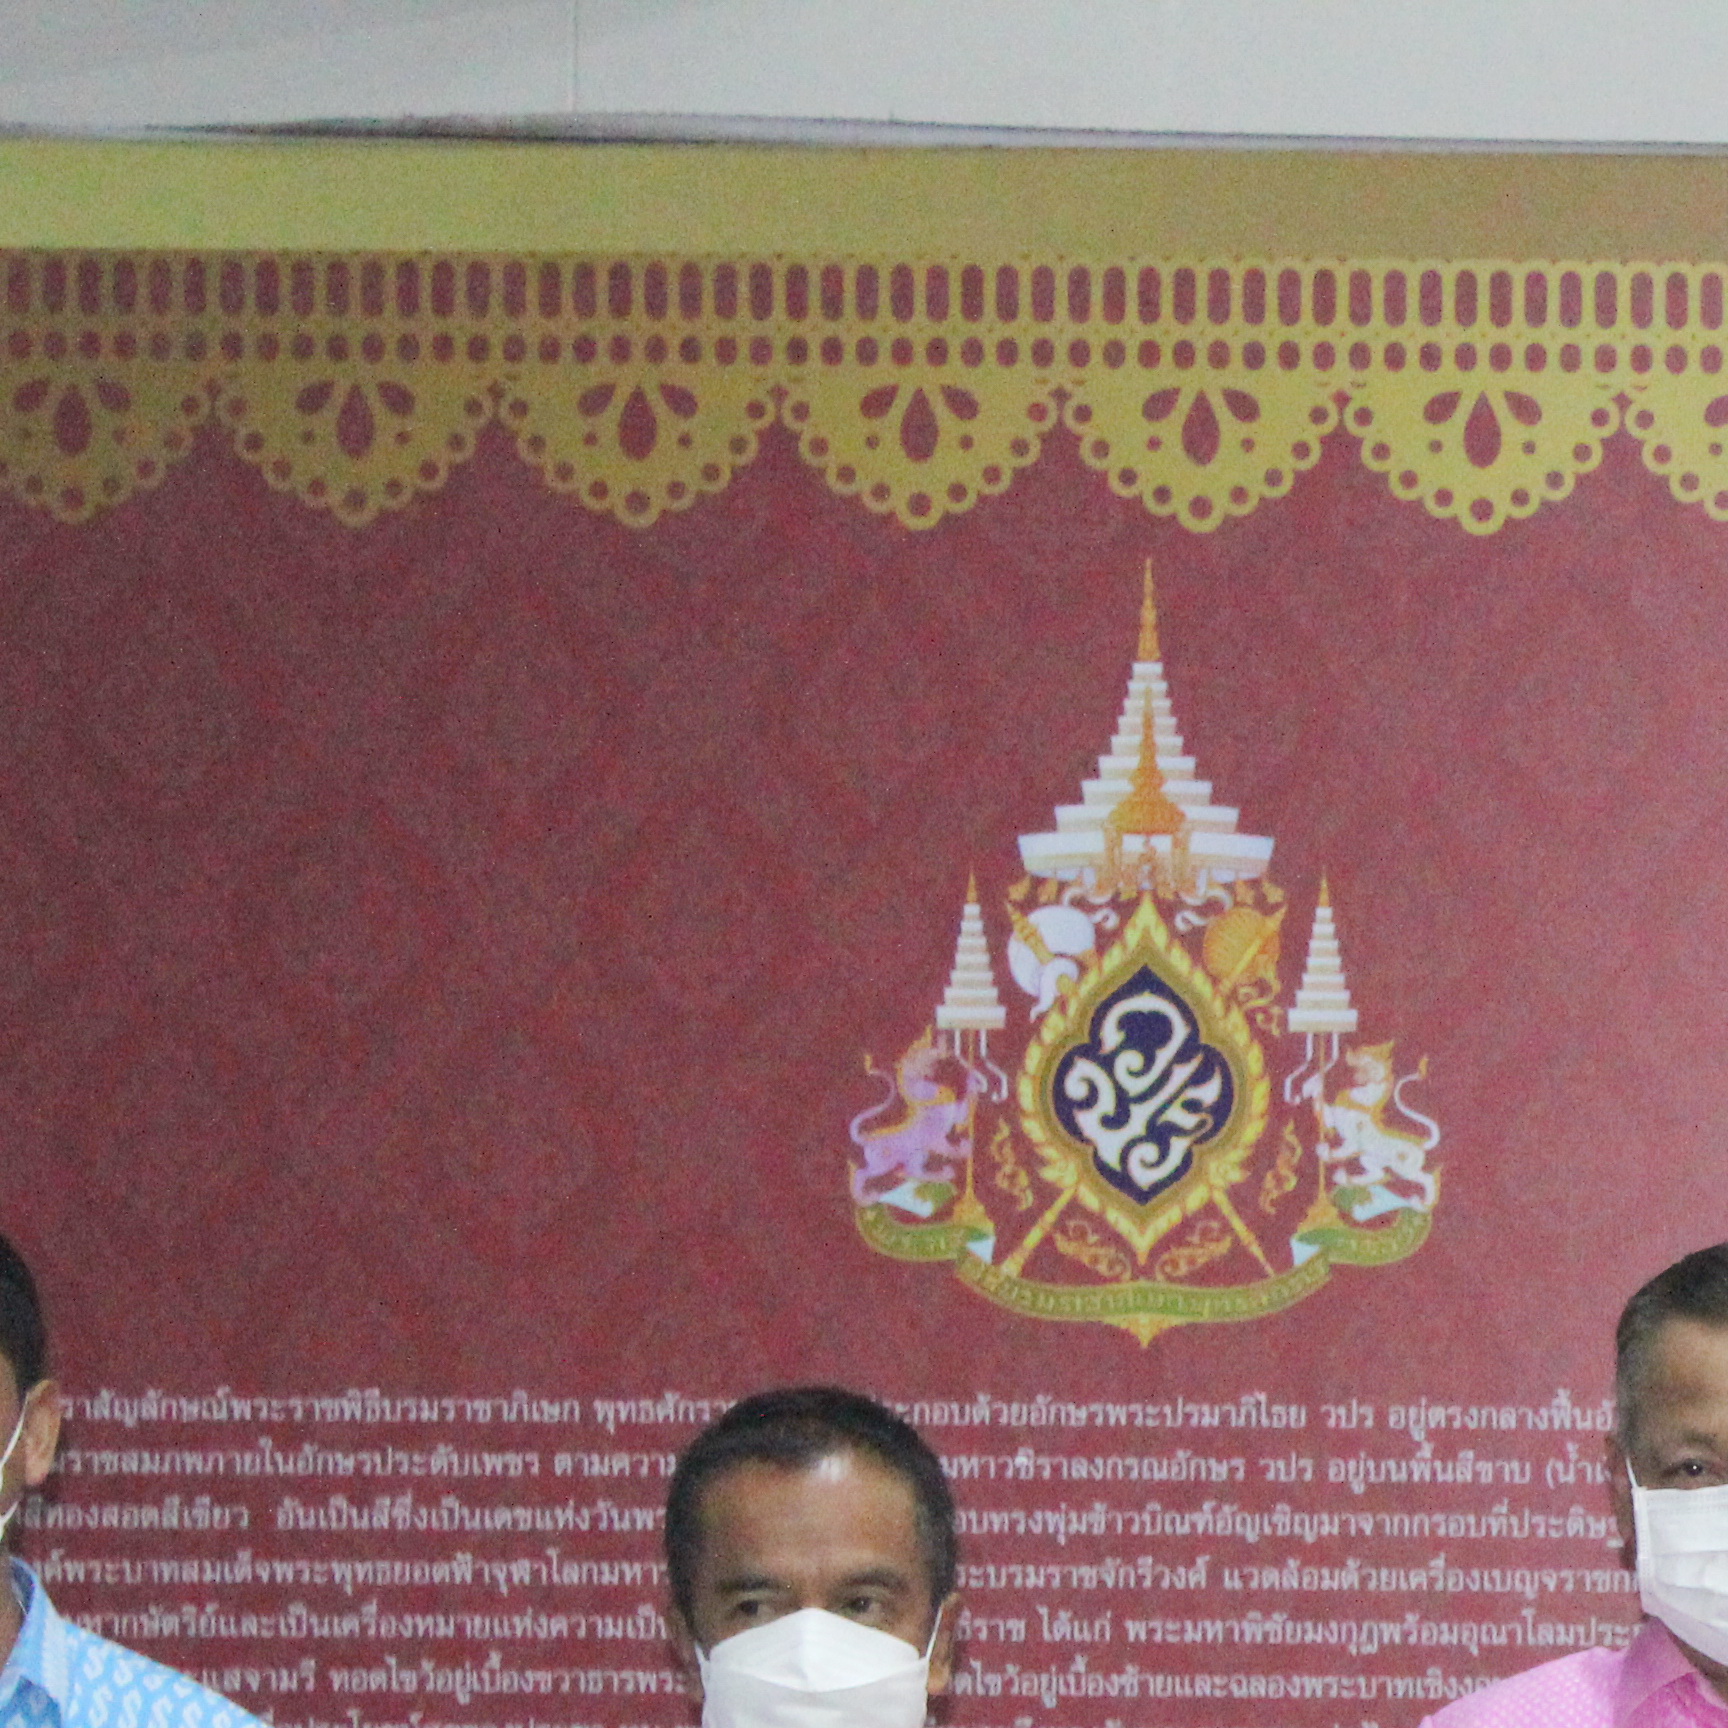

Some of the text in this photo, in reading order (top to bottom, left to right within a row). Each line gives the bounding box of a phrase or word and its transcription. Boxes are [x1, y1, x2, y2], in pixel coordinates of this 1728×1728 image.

[1321, 1401, 1374, 1429] วปร
[1260, 1454, 1313, 1480] วปร
[1036, 1605, 1112, 1642] ได้แก่
